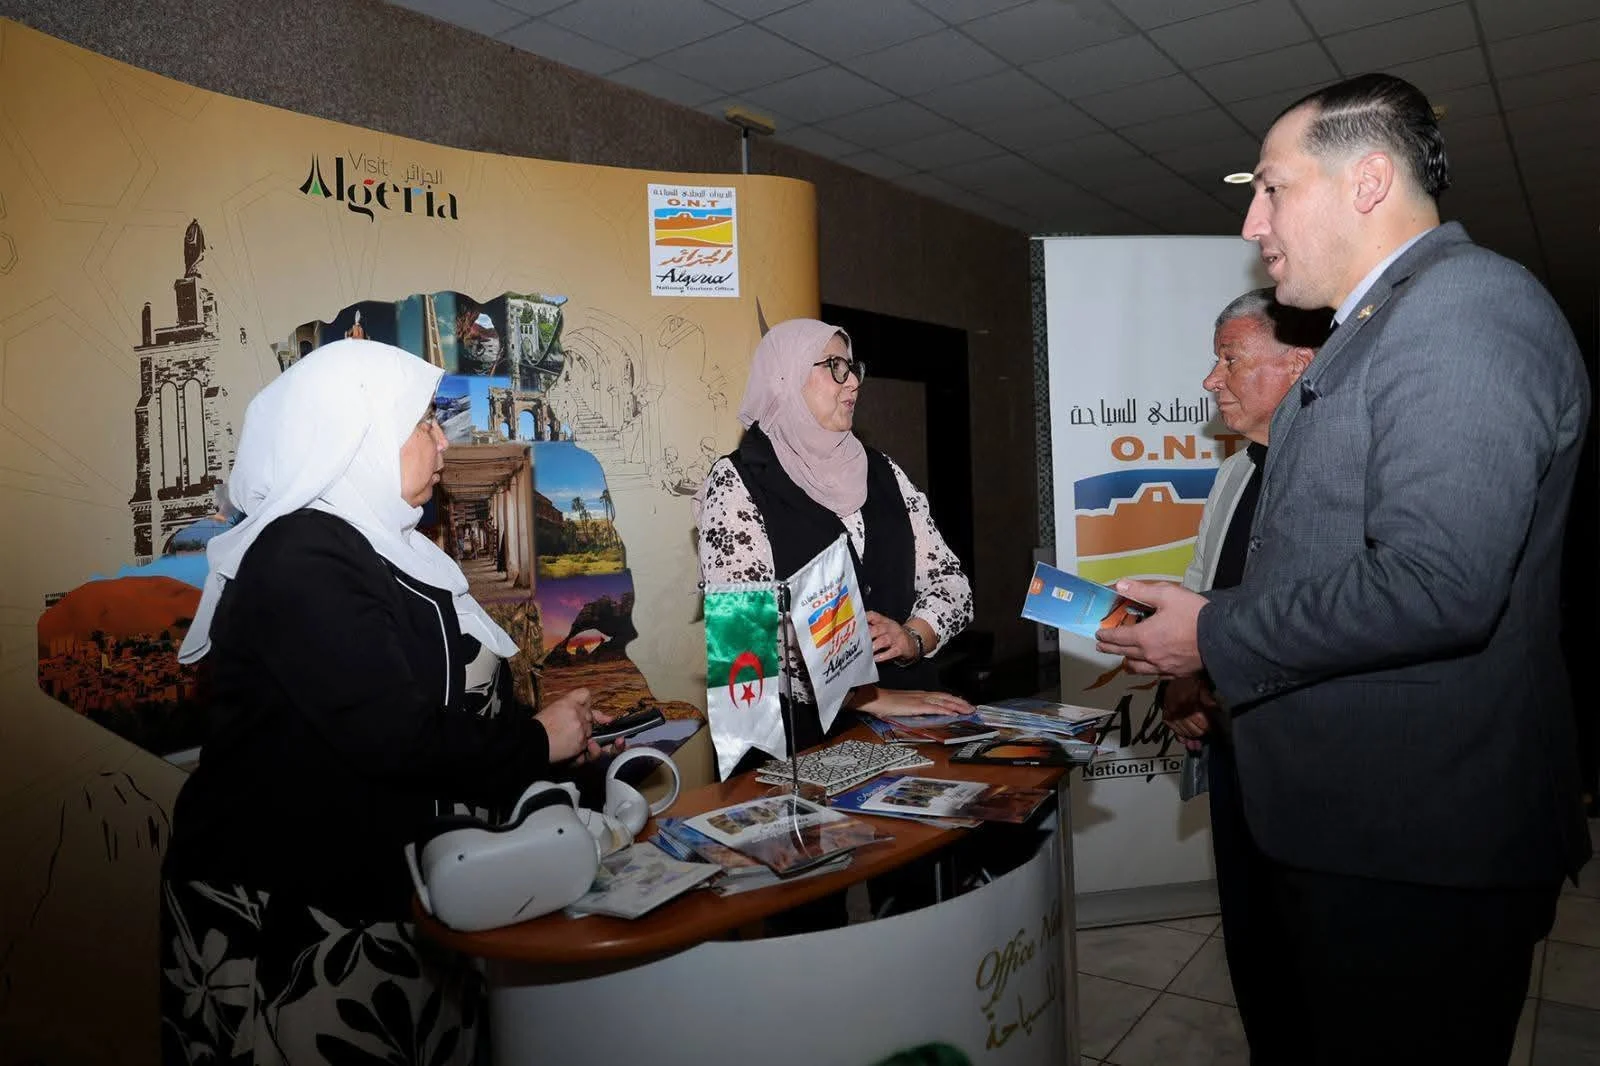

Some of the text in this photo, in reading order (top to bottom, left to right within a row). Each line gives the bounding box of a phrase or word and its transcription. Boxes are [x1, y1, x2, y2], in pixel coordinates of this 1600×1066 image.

[349, 149, 388, 177] Visit
[402, 162, 443, 185] الجزائر
[299, 152, 459, 223] Algeria
[667, 198, 720, 208] O.N.T
[657, 248, 734, 268] الجزائر
[655, 268, 734, 291] Algeria
[1070, 396, 1210, 426] الوطني للسياحة
[1081, 760, 1154, 778] National
[975, 928, 1035, 1011] Office
